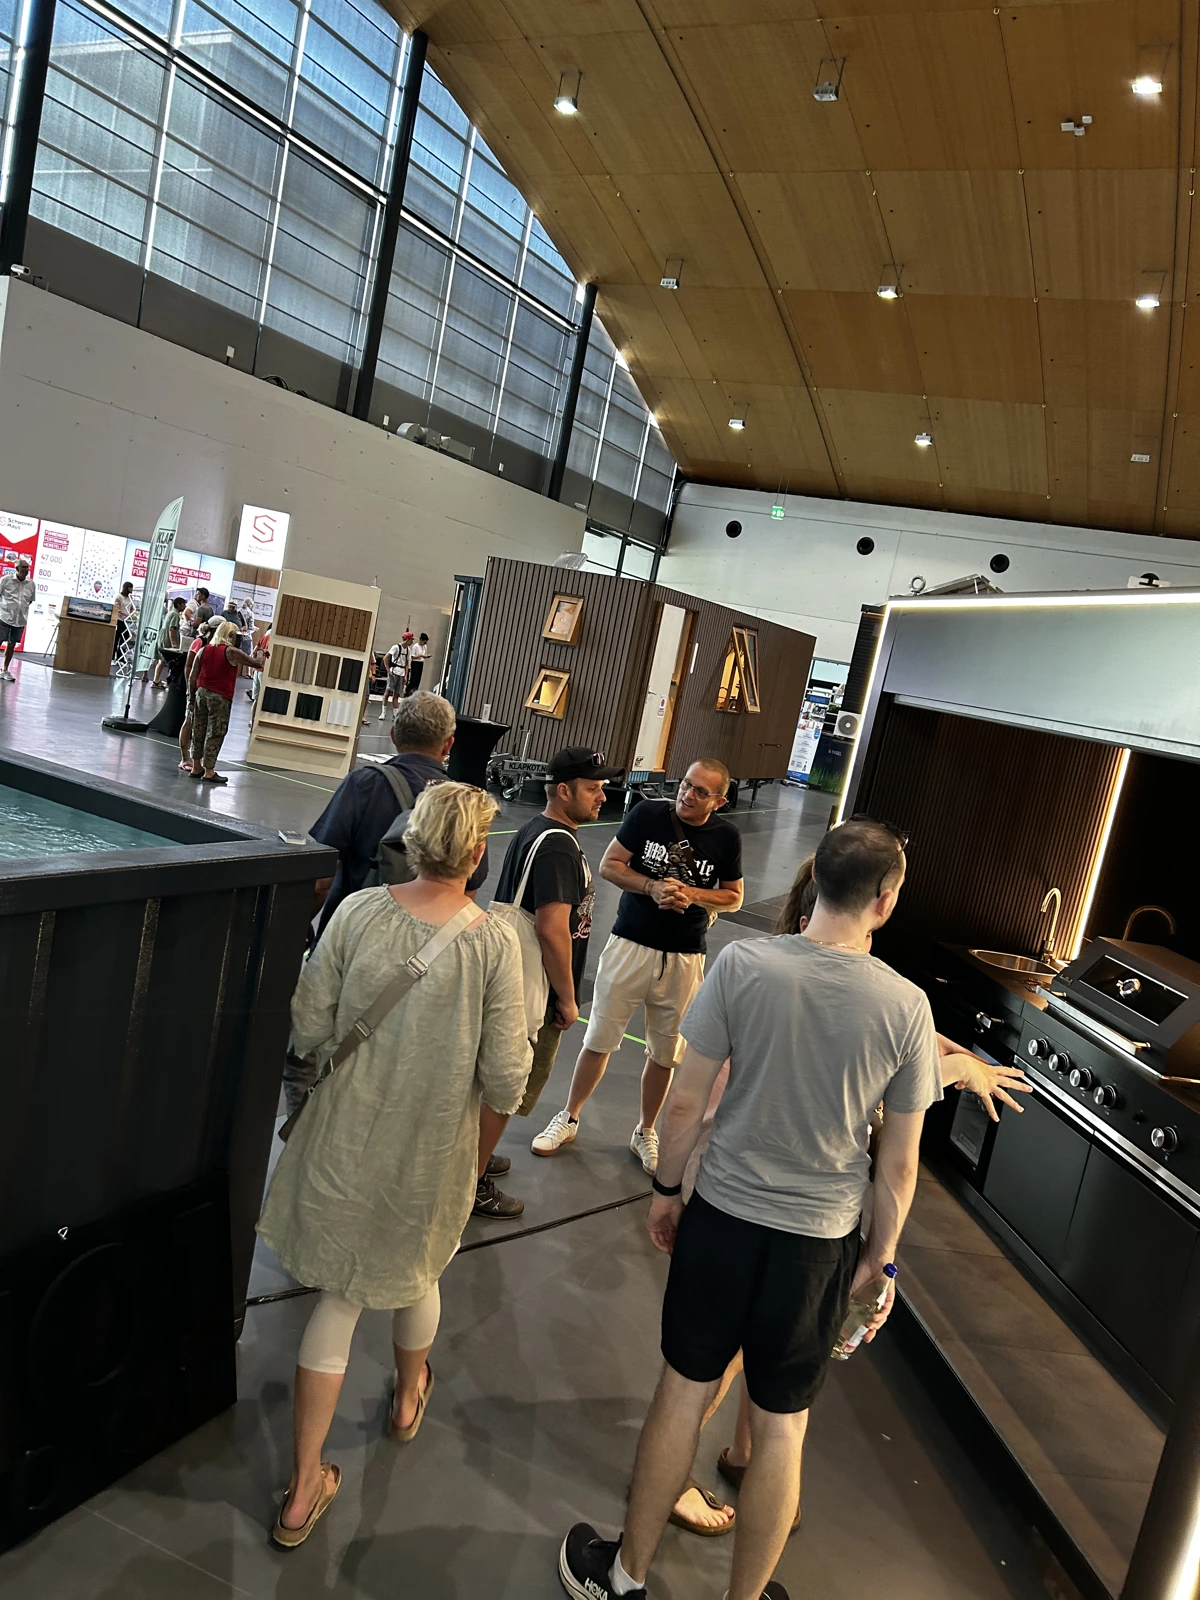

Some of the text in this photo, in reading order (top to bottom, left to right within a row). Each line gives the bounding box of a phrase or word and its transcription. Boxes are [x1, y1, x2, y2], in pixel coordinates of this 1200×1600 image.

[50, 556, 63, 564] 000
[38, 569, 52, 578] 800
[37, 584, 49, 592] 100
[584, 1577, 609, 1600] HOKA
